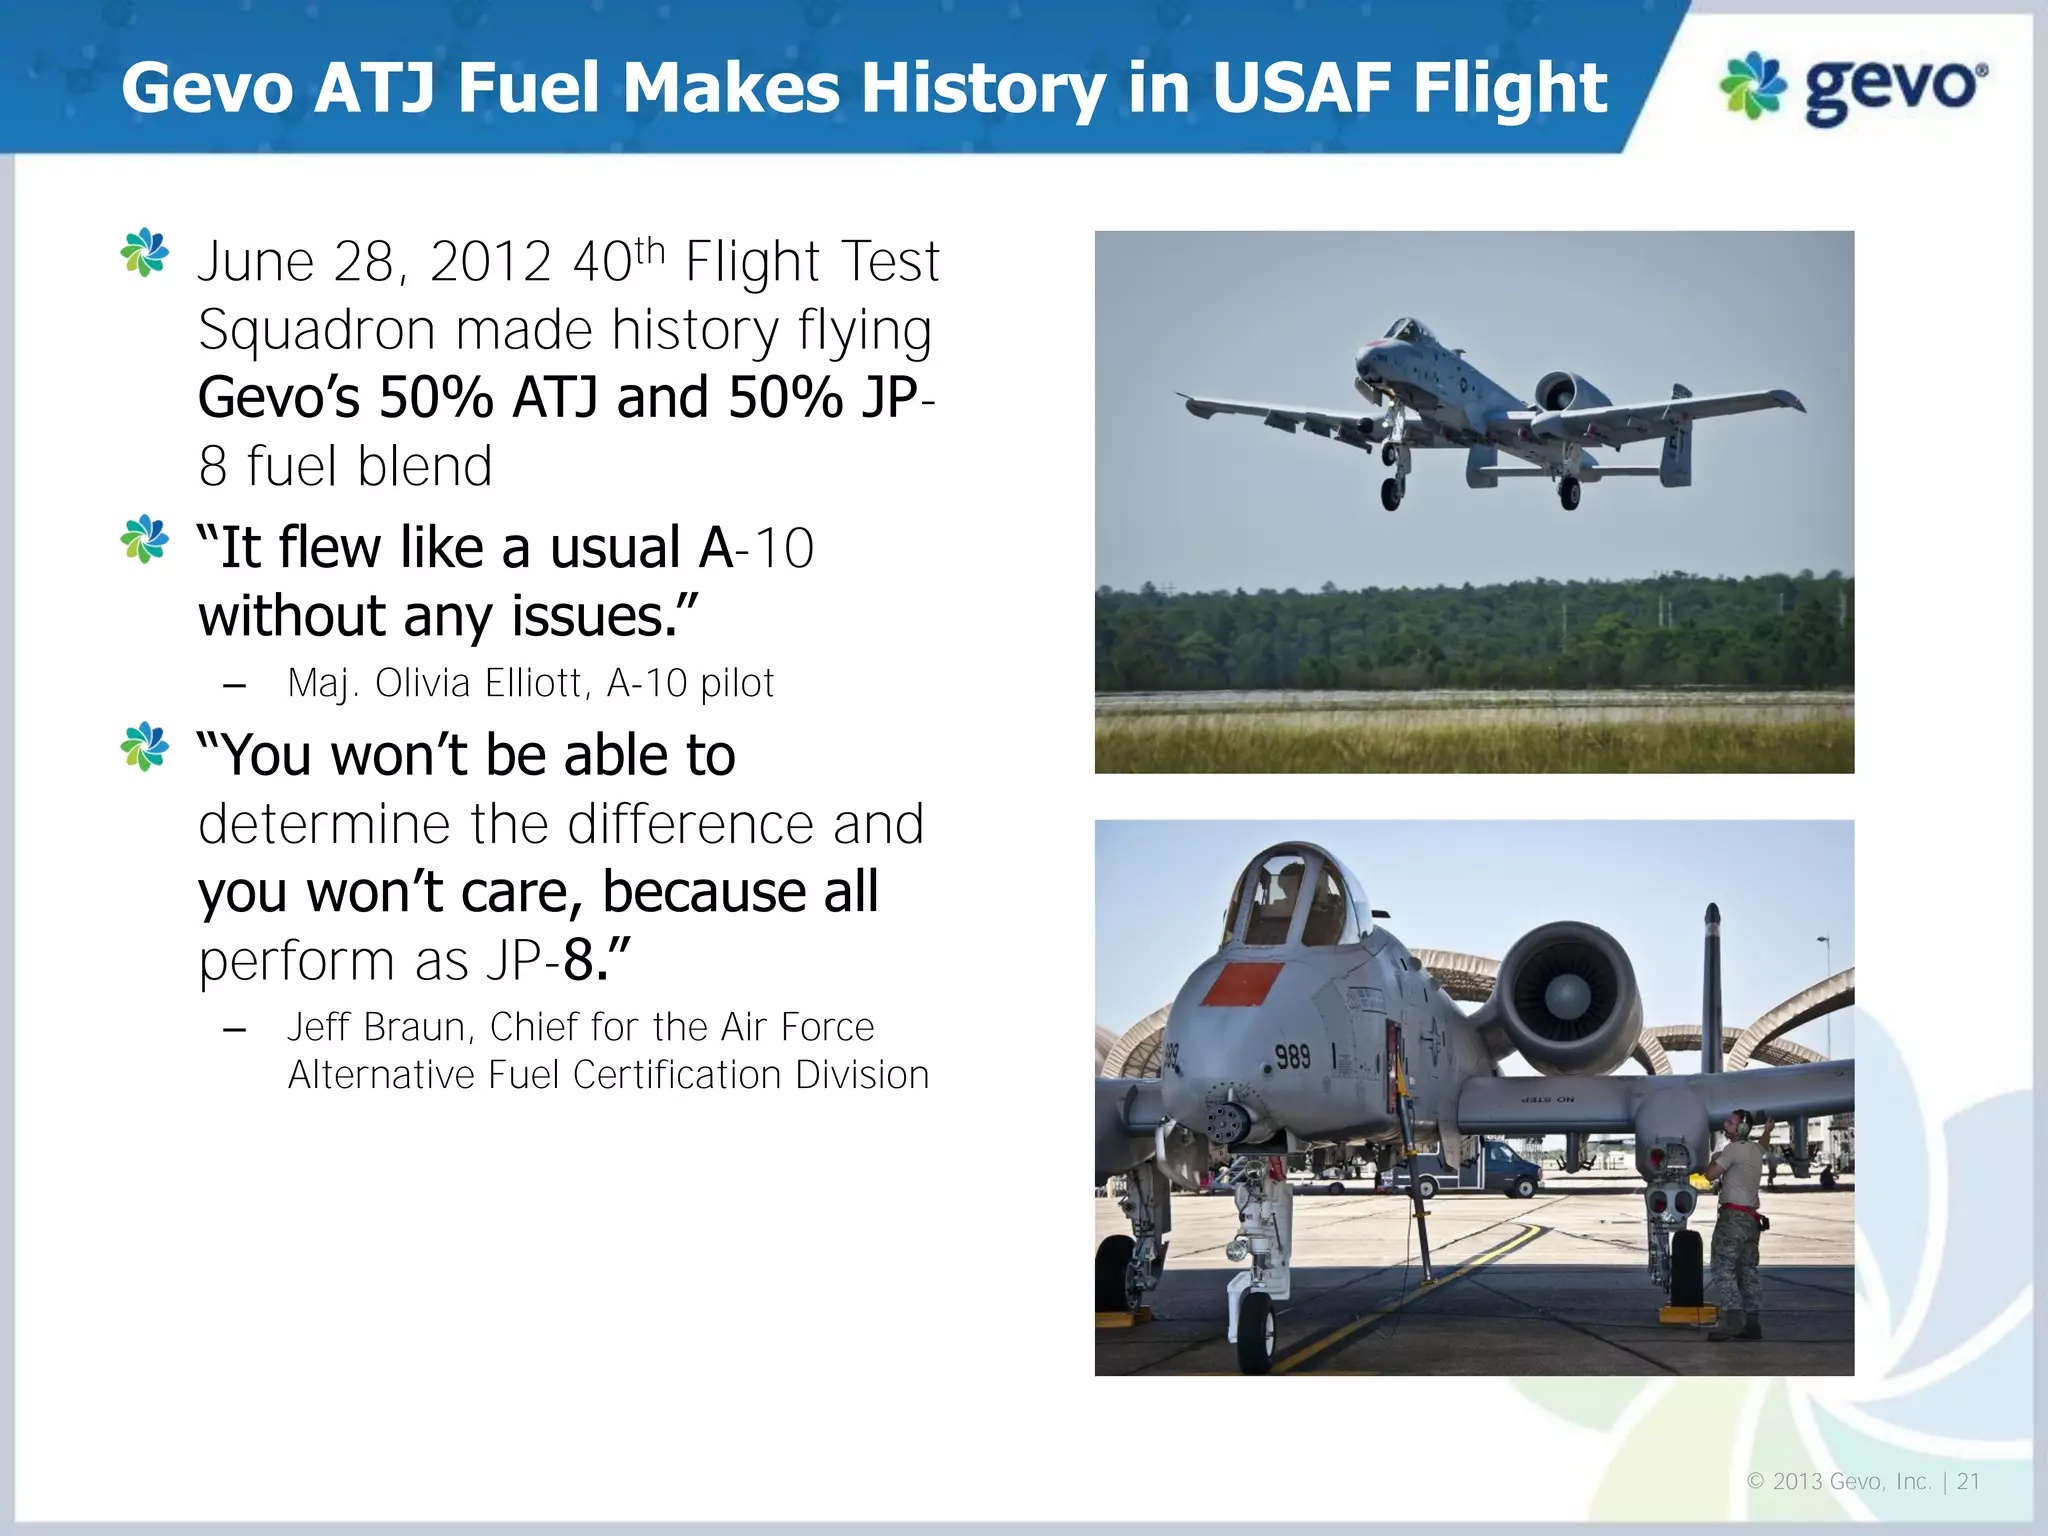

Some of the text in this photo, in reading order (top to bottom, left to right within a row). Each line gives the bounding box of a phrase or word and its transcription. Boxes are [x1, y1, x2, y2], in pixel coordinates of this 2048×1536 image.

[121, 59, 1608, 127] Gevo ATJ Fuel Makes History in USAF Flight
[197, 236, 940, 294] June 28, 2012 40th Flight Test
[200, 307, 930, 362] Squadron made history flying
[381, 374, 494, 419] 50%
[512, 374, 596, 419] ATJ
[618, 373, 707, 419] and
[731, 374, 843, 419] 50%
[863, 375, 936, 418] JP-
[200, 444, 491, 487] 8 fuel blend
[279, 523, 382, 569] flew
[403, 523, 484, 569] like
[502, 534, 529, 569] a
[553, 523, 679, 569] usual
[699, 525, 813, 568] A-10
[199, 592, 386, 637] without
[405, 603, 494, 648] any
[289, 667, 774, 706] Maj. Olivia Elliott, A-10 pilot
[489, 731, 546, 777] be
[565, 731, 668, 777] able
[686, 734, 736, 777] to
[200, 802, 922, 845] determine the difference and
[198, 879, 286, 924] you
[462, 879, 582, 923] care,
[605, 867, 806, 913] because
[825, 867, 877, 913] all
[201, 938, 393, 993] perform
[417, 948, 468, 981] as
[287, 1011, 875, 1045] Jeff Braun, Chief for the Air Force
[288, 1058, 928, 1090] Alternative Fuel Certification Division
[1275, 1043, 1311, 1070] 989
[1773, 1471, 1823, 1491] 2013
[1830, 1471, 1886, 1493] Gevo,
[1897, 1471, 1932, 1491] Inc.
[1957, 1471, 1979, 1491] 21
